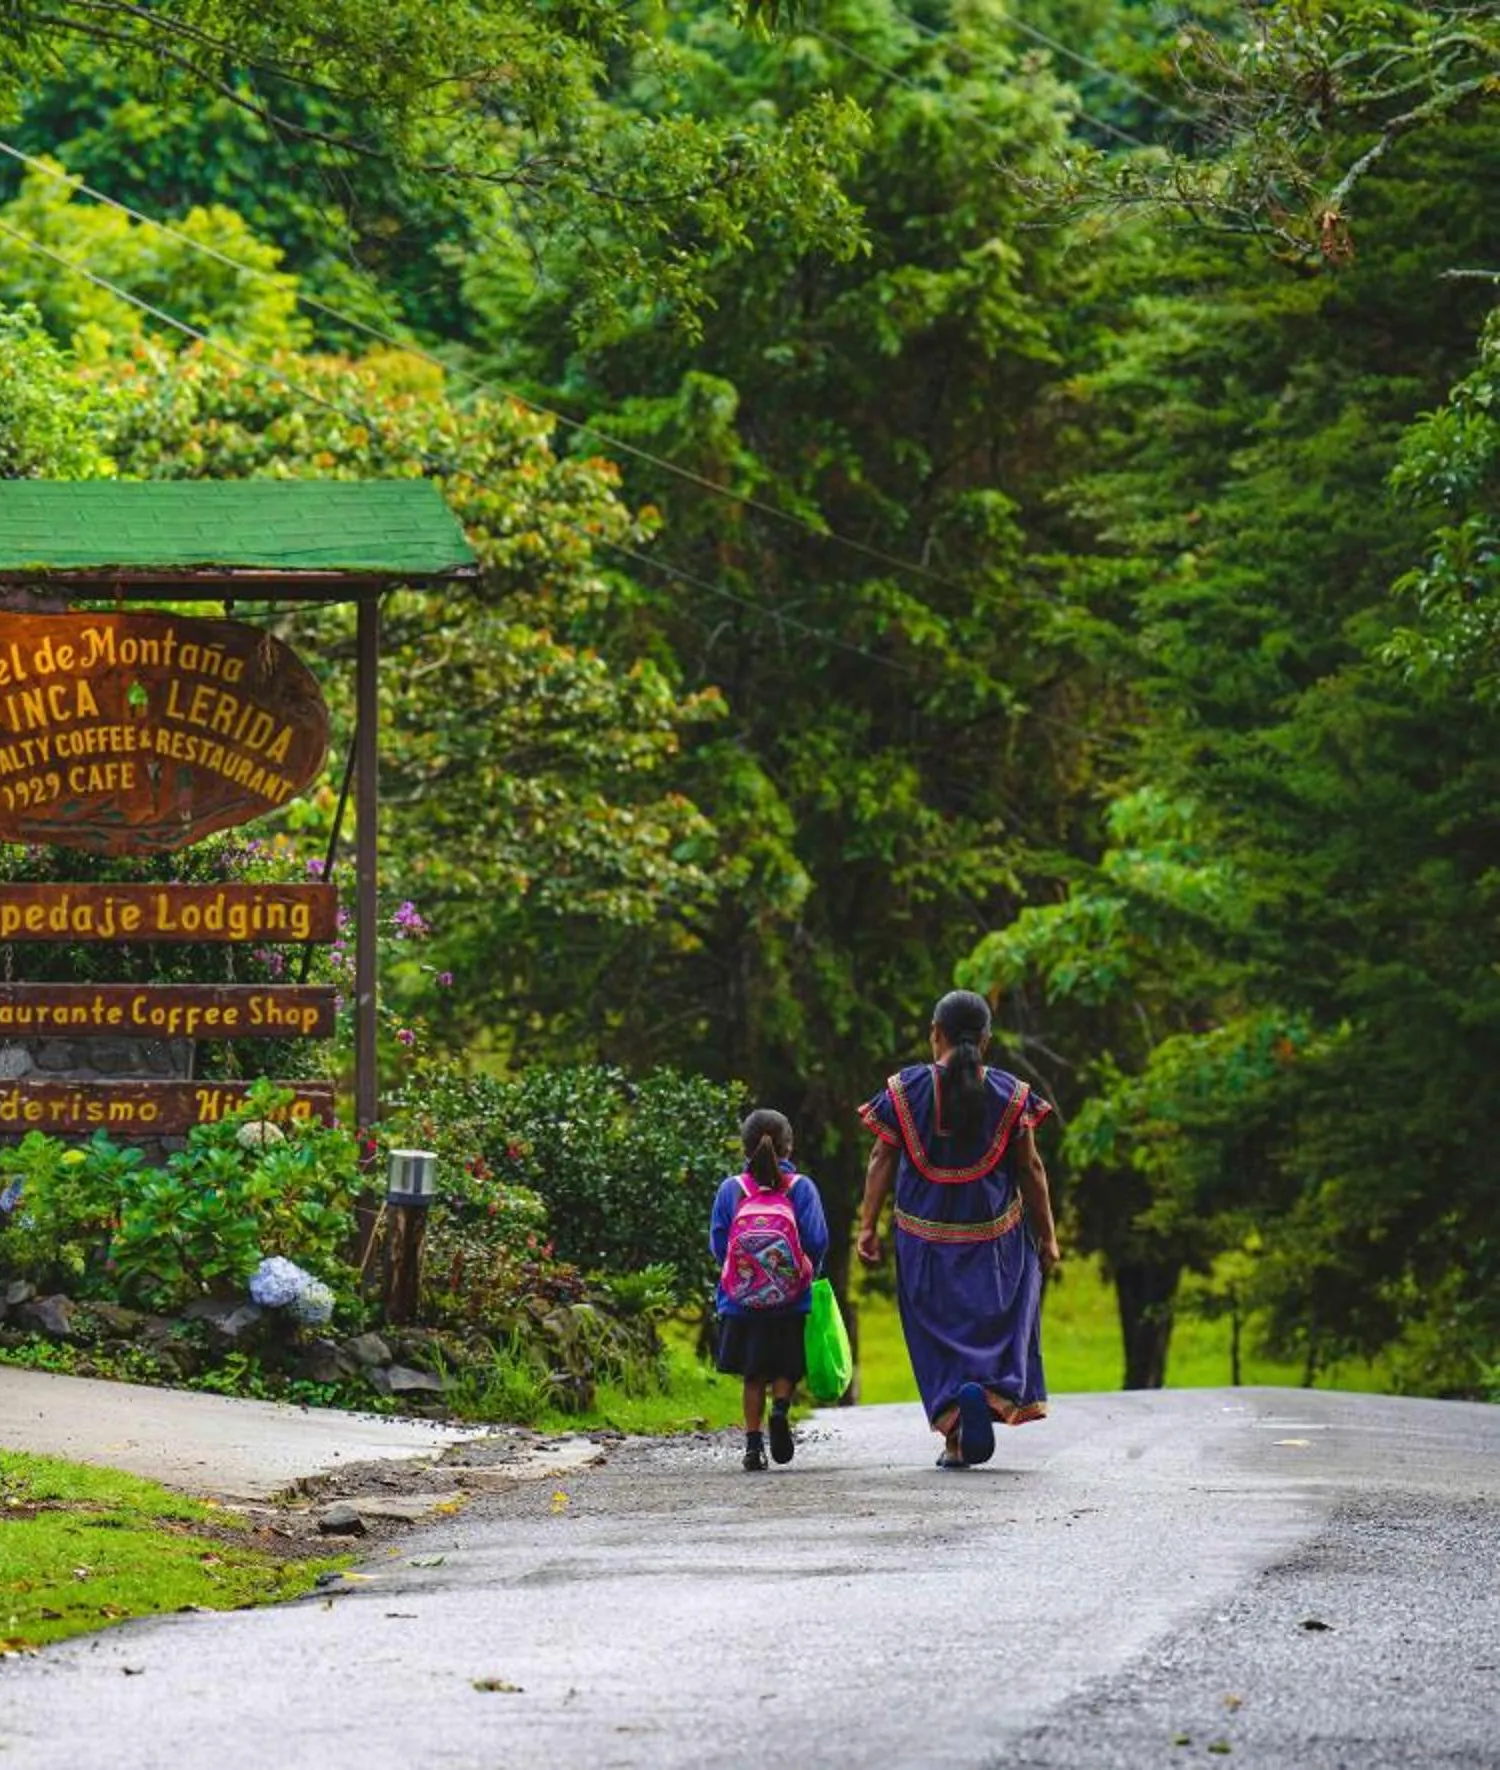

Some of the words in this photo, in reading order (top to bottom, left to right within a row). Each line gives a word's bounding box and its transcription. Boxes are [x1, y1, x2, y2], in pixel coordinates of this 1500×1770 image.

[34, 636, 76, 675] de
[79, 625, 245, 684] Montaña
[165, 678, 294, 766] LERIDA
[2, 772, 61, 812] 1929
[68, 761, 136, 793] CAFE
[55, 725, 136, 758] COFFEE
[155, 728, 294, 804] RESTAURANT
[155, 893, 311, 940] Lodging
[131, 995, 240, 1034] Coffee
[249, 996, 319, 1032] Shop
